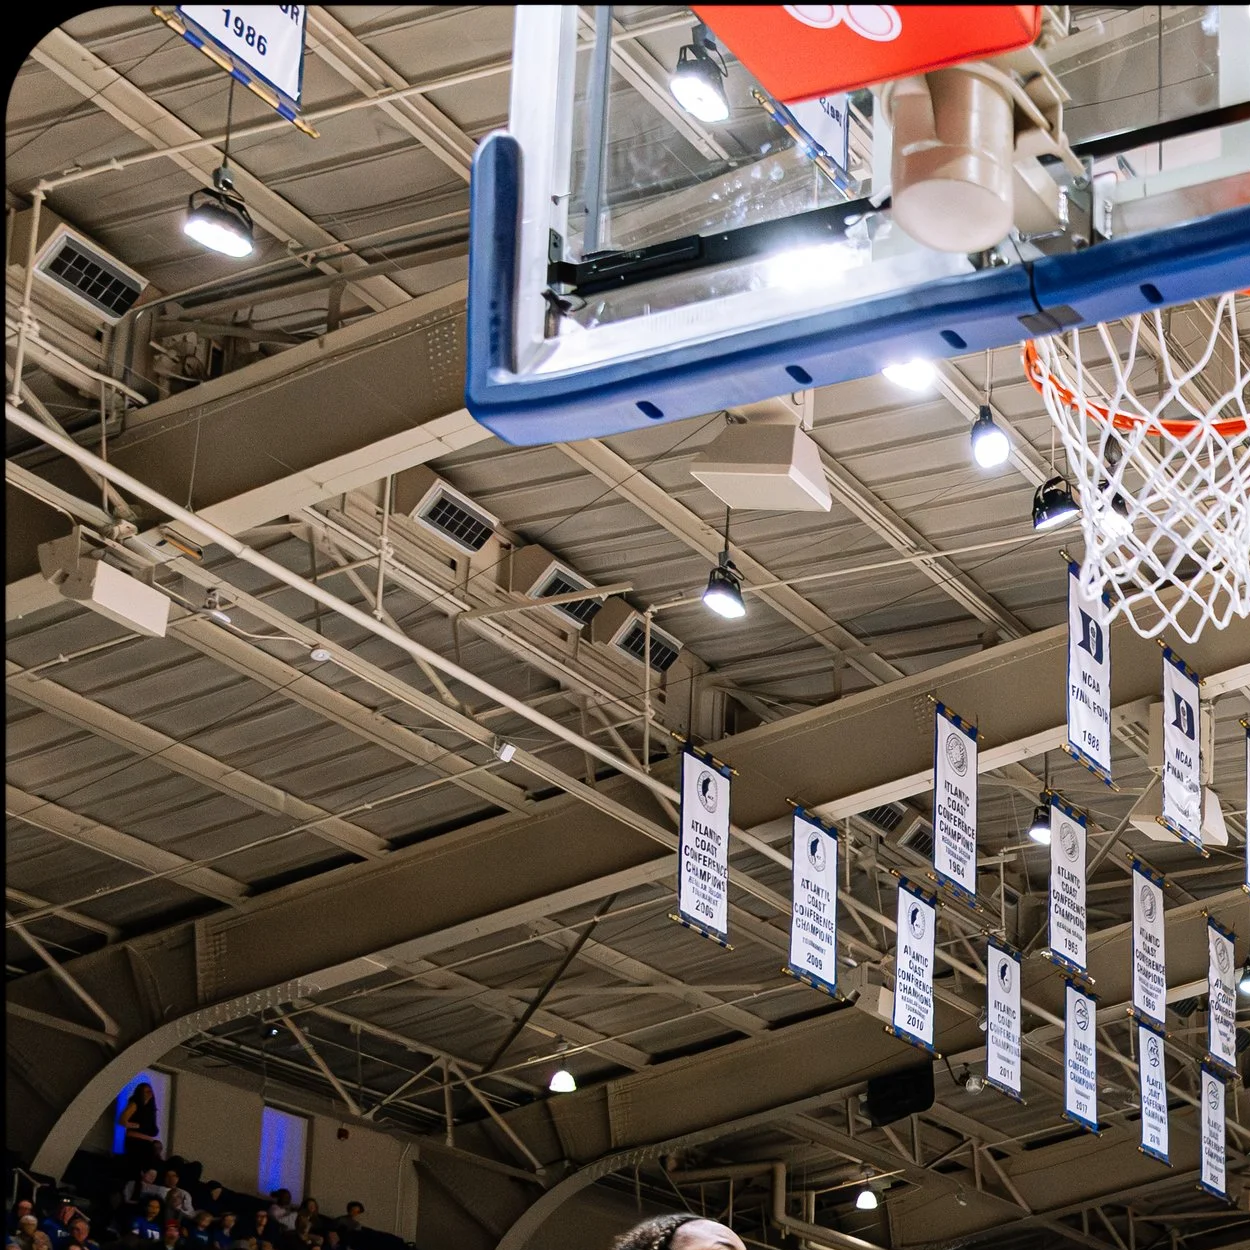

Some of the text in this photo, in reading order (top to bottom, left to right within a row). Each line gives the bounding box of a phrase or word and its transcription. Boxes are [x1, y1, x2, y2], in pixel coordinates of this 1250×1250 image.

[222, 9, 267, 56] 1986
[1082, 671, 1101, 695] NCAA
[1082, 730, 1100, 751] 1988
[1175, 748, 1193, 770] NCAA
[944, 780, 970, 808] ATLANTIC
[947, 797, 966, 818] COAST
[691, 820, 721, 846] ATLANTIC
[938, 804, 975, 839] CONFERENCE
[695, 836, 717, 858] COAST
[939, 819, 974, 853] CHAMPIONS
[684, 845, 728, 879] CONFERENCE
[949, 859, 965, 878] 1964
[686, 861, 725, 892] CHAMPIONS
[1057, 865, 1080, 889] ATLANTIC
[1061, 881, 1077, 899] COAST
[695, 900, 714, 919] 2006
[807, 892, 827, 914] COAST
[794, 902, 834, 933] CONFERENCE
[795, 918, 833, 945] CHAMPIONS
[806, 952, 823, 970] 2009
[906, 1014, 924, 1031] 2010
[999, 1065, 1013, 1081] 2011
